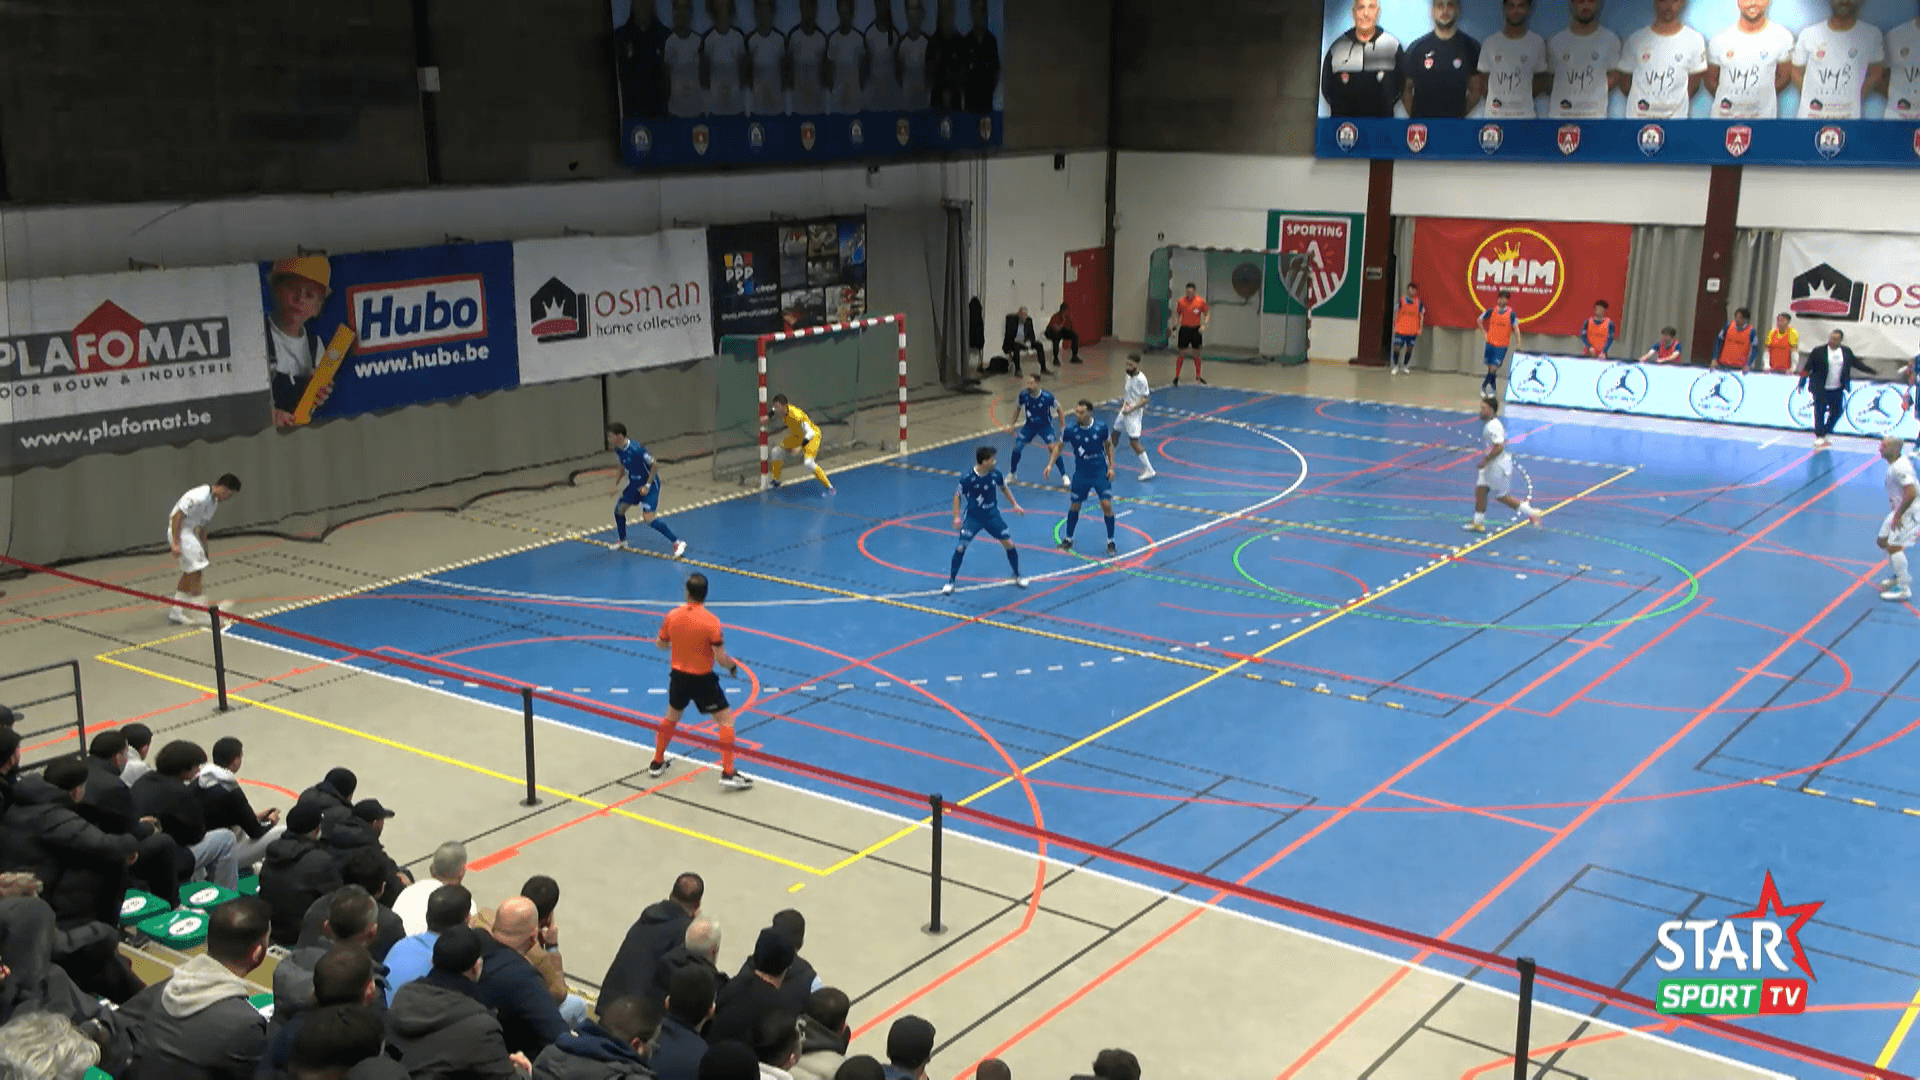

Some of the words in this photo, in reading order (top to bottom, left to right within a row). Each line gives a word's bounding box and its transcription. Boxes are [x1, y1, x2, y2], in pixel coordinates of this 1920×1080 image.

[1286, 223, 1344, 238] SPORTING
[1477, 256, 1556, 286] MHM
[361, 289, 478, 340] Hubo
[595, 281, 701, 317] osman
[596, 322, 633, 337] home
[637, 313, 702, 331] collections
[355, 342, 490, 378] www.hubo.be
[53, 376, 109, 394] BOUW
[120, 373, 131, 386] &
[142, 362, 233, 382] INDUSTRIE
[20, 408, 212, 450] www.plafomat.be
